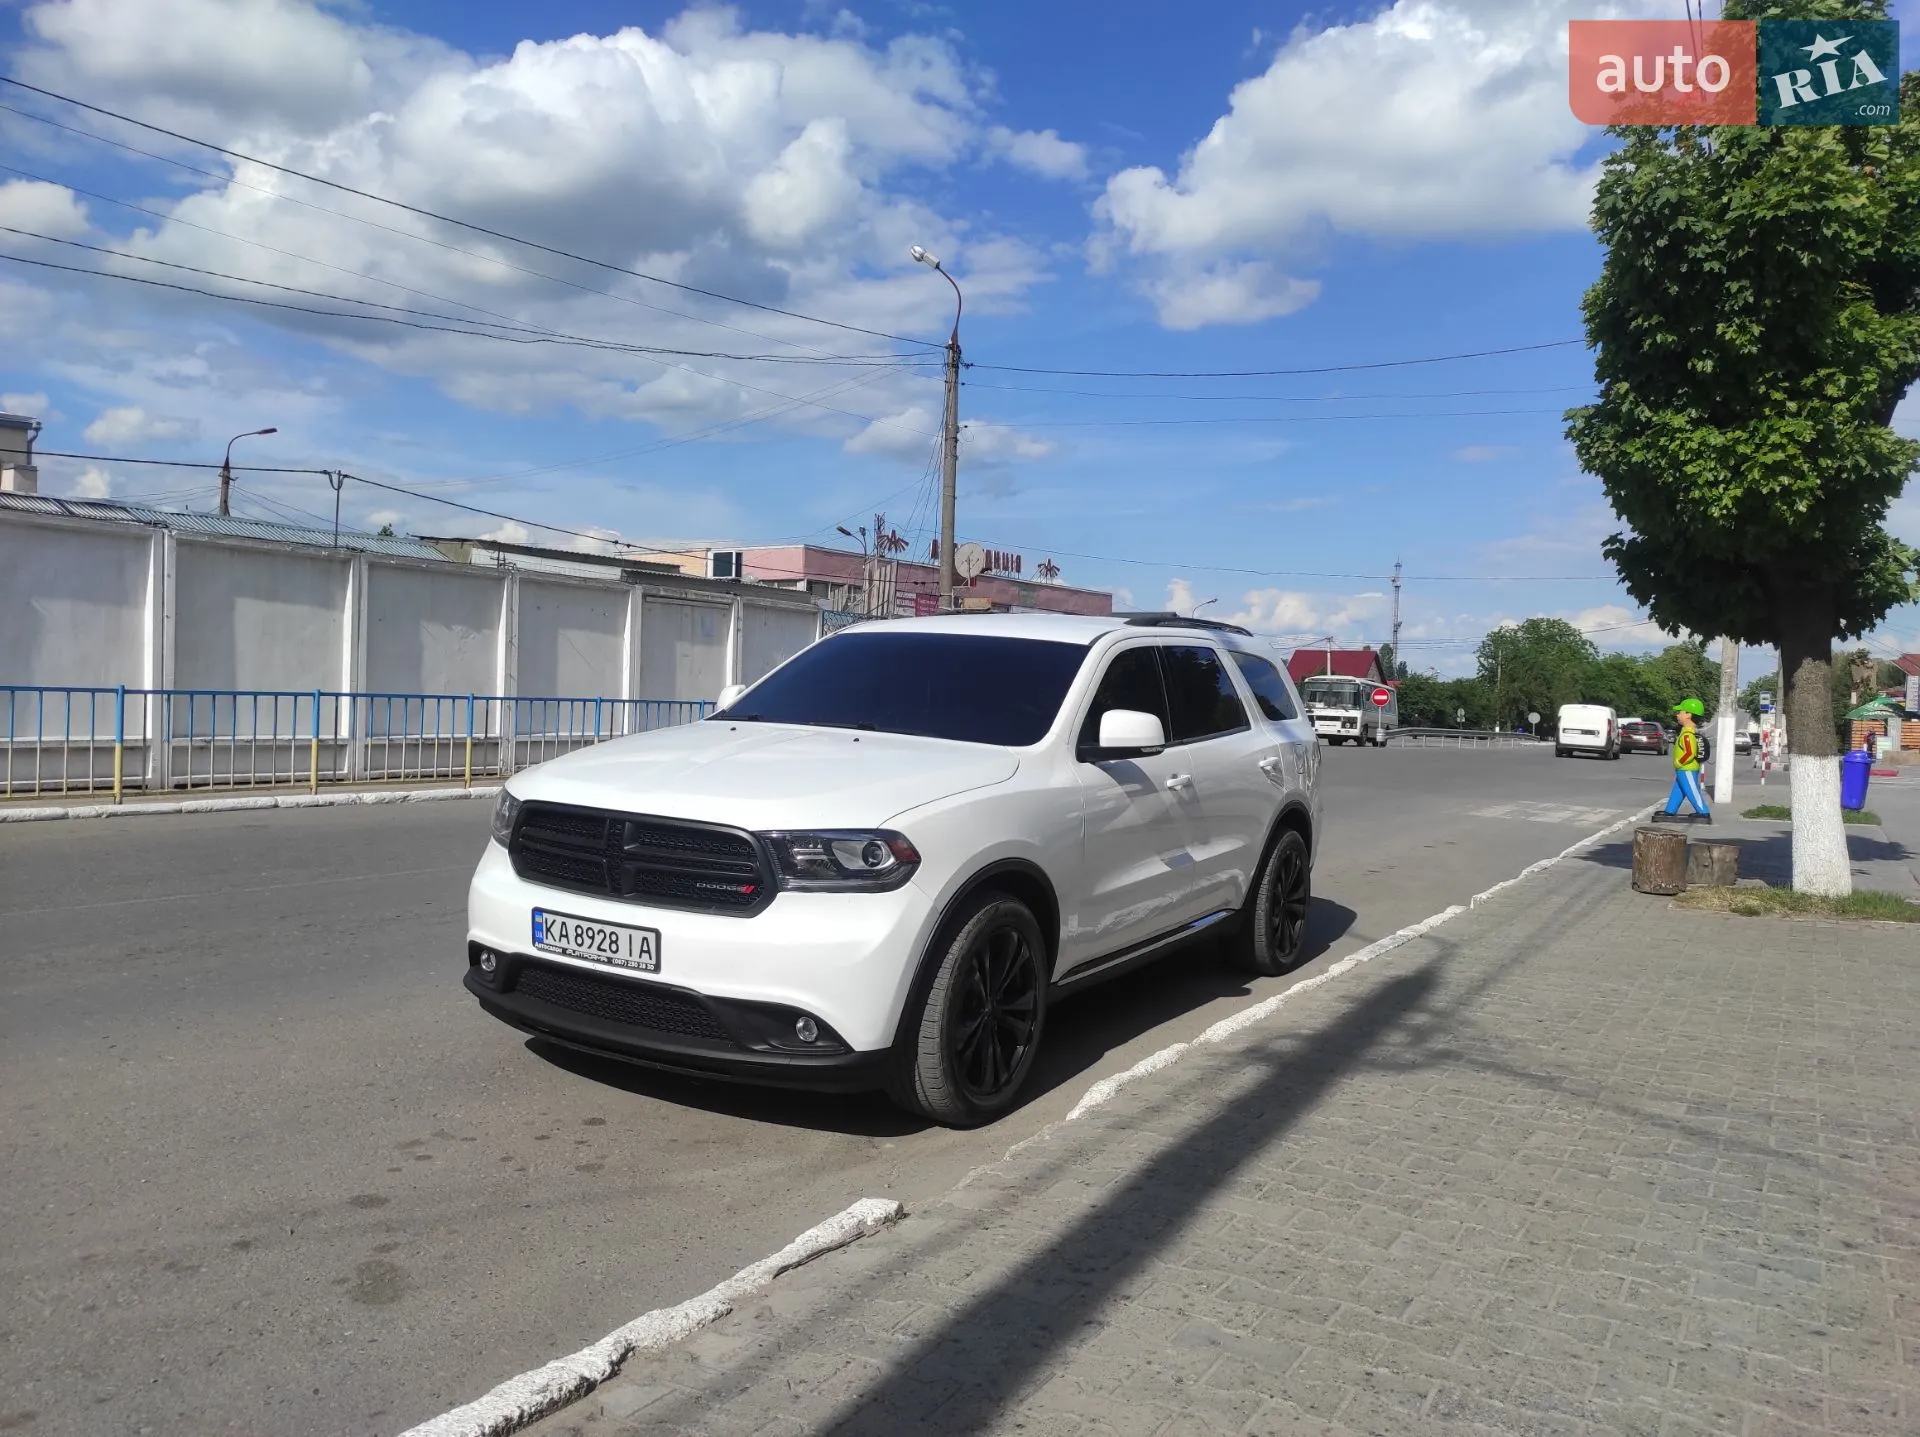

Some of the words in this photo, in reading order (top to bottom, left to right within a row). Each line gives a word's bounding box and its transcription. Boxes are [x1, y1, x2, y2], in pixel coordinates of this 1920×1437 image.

[696, 882, 744, 893] DODGE
[544, 917, 570, 945] KA
[574, 924, 619, 955] 8928
[628, 933, 653, 961] IA
